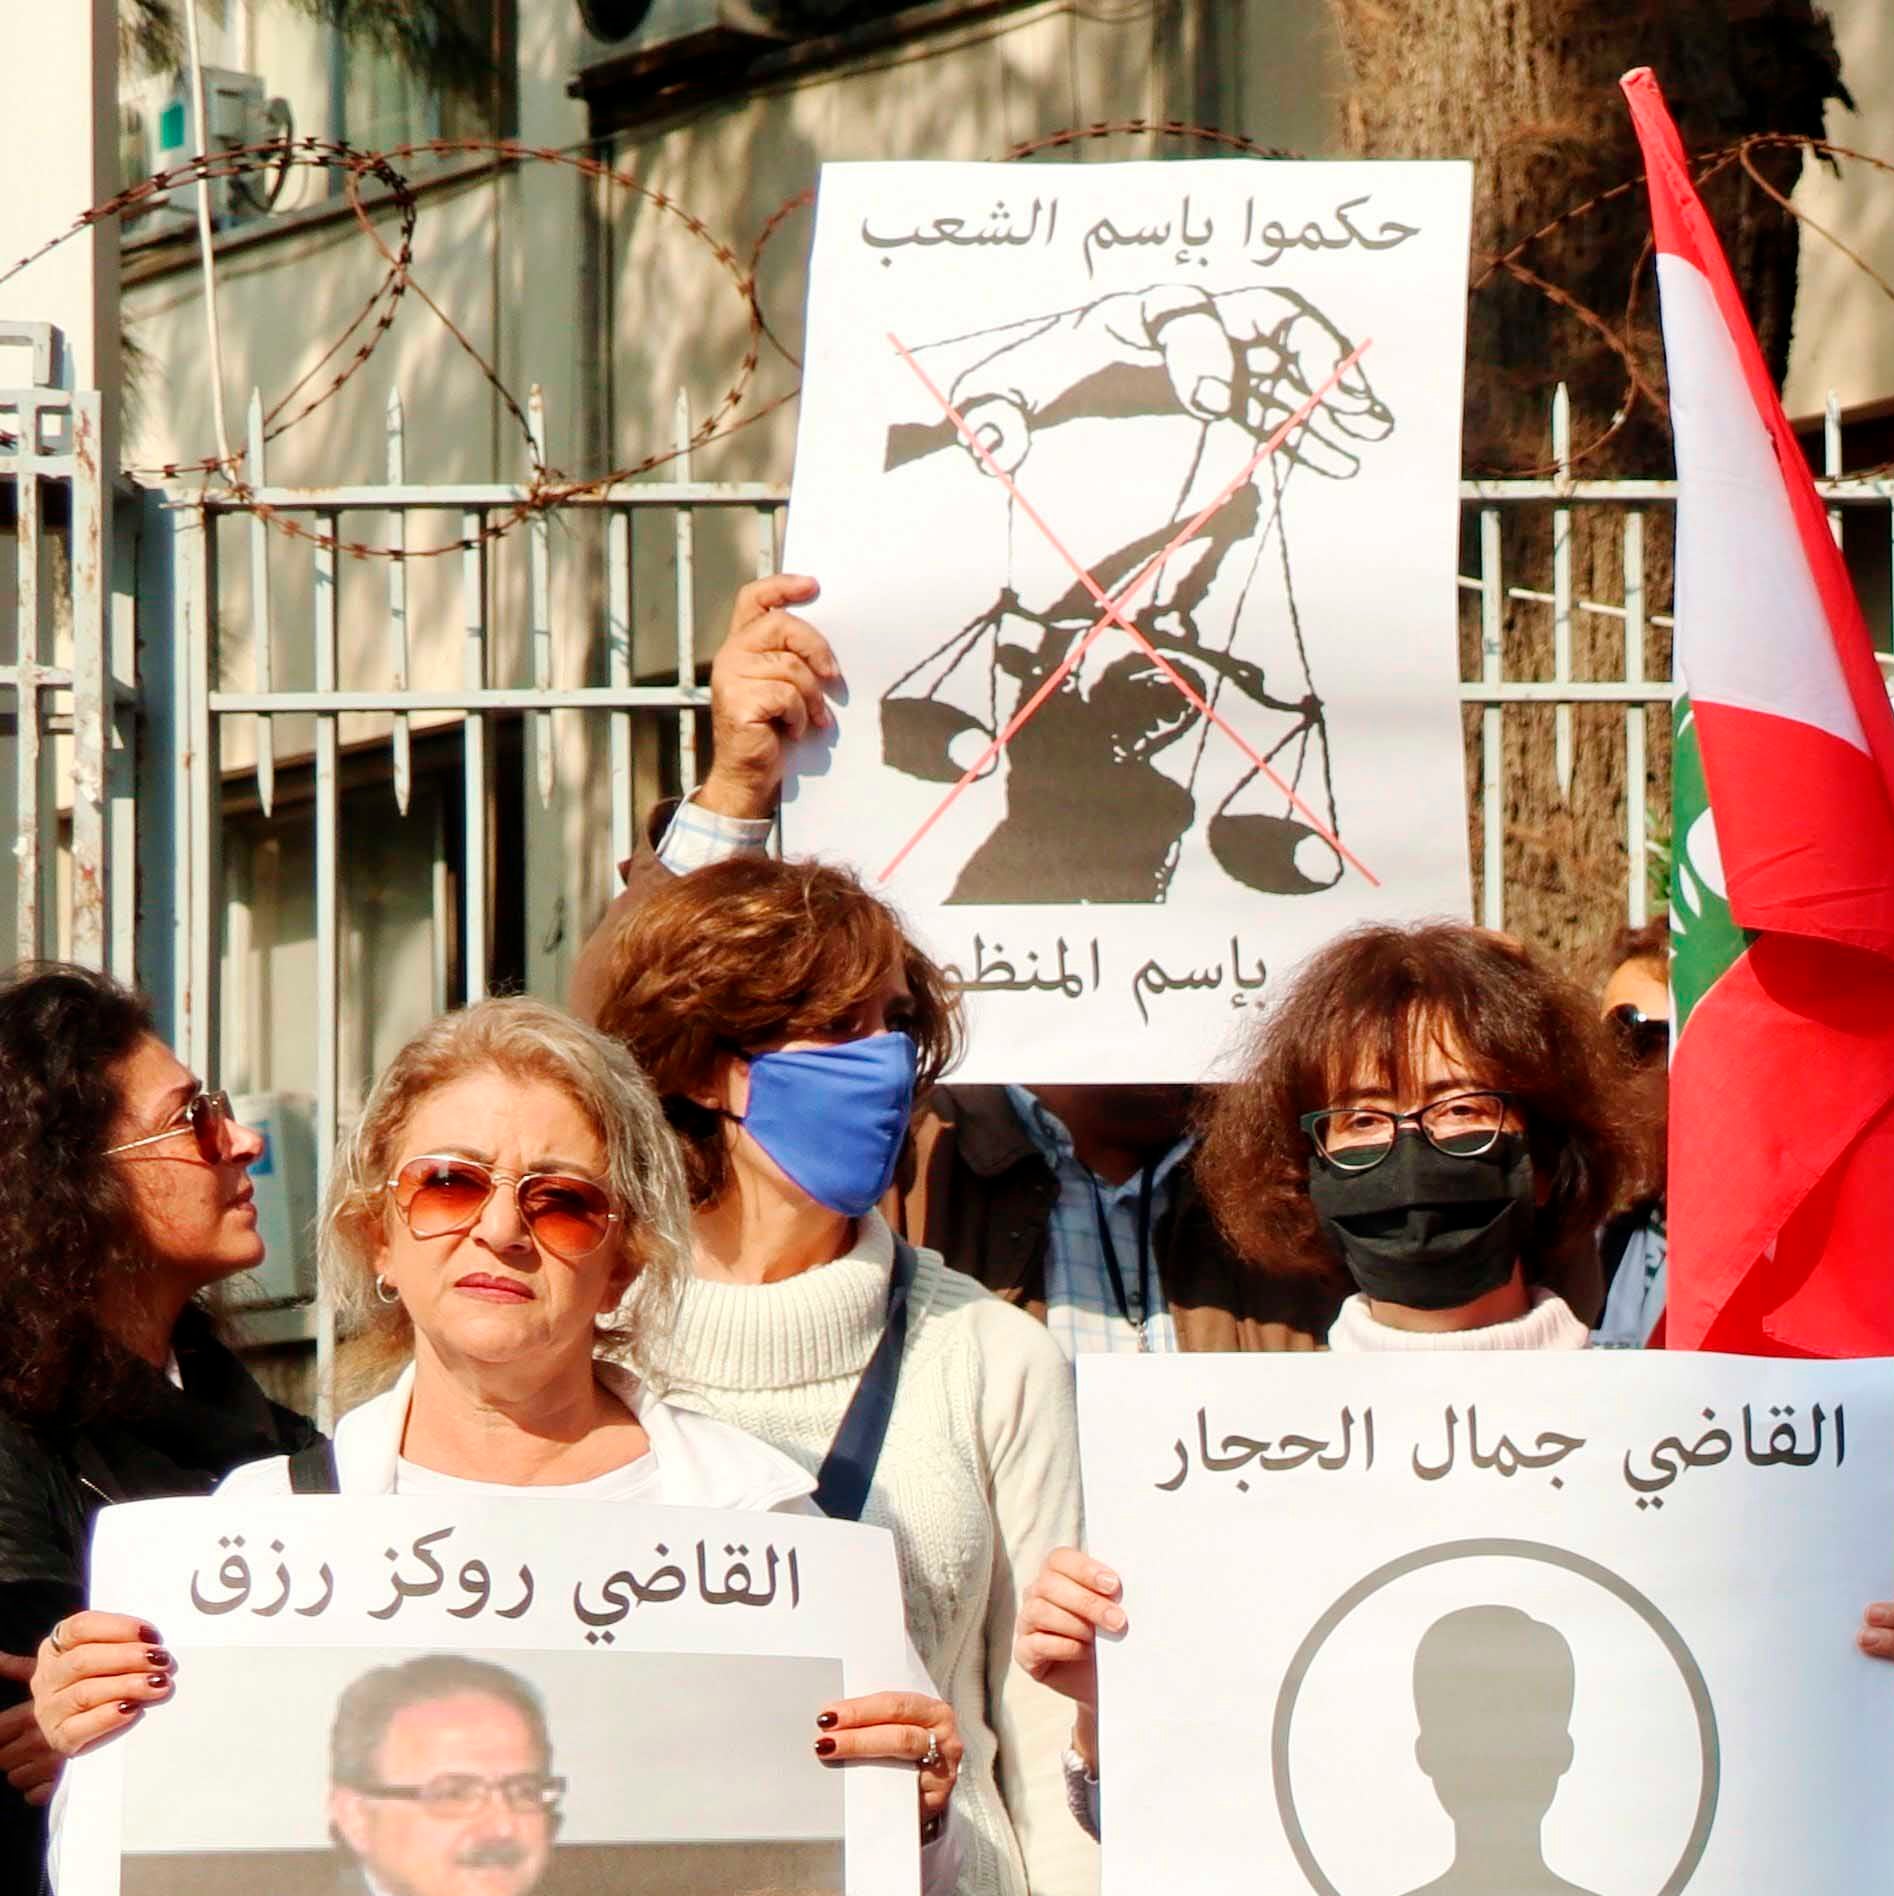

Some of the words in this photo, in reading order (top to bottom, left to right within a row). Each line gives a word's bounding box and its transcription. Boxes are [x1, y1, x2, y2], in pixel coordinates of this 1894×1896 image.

[862, 198, 1057, 268] الشعب
[1083, 196, 1213, 280] بإسم
[1244, 195, 1421, 267] حكموا
[1133, 936, 1267, 1025] بإسم
[1155, 1406, 1374, 1493] الحجار
[1412, 1404, 1586, 1490] جمال
[1624, 1402, 1845, 1510] القاضي
[190, 1535, 333, 1617] رزق
[367, 1527, 534, 1620] روكز
[574, 1540, 799, 1645] القاضي
